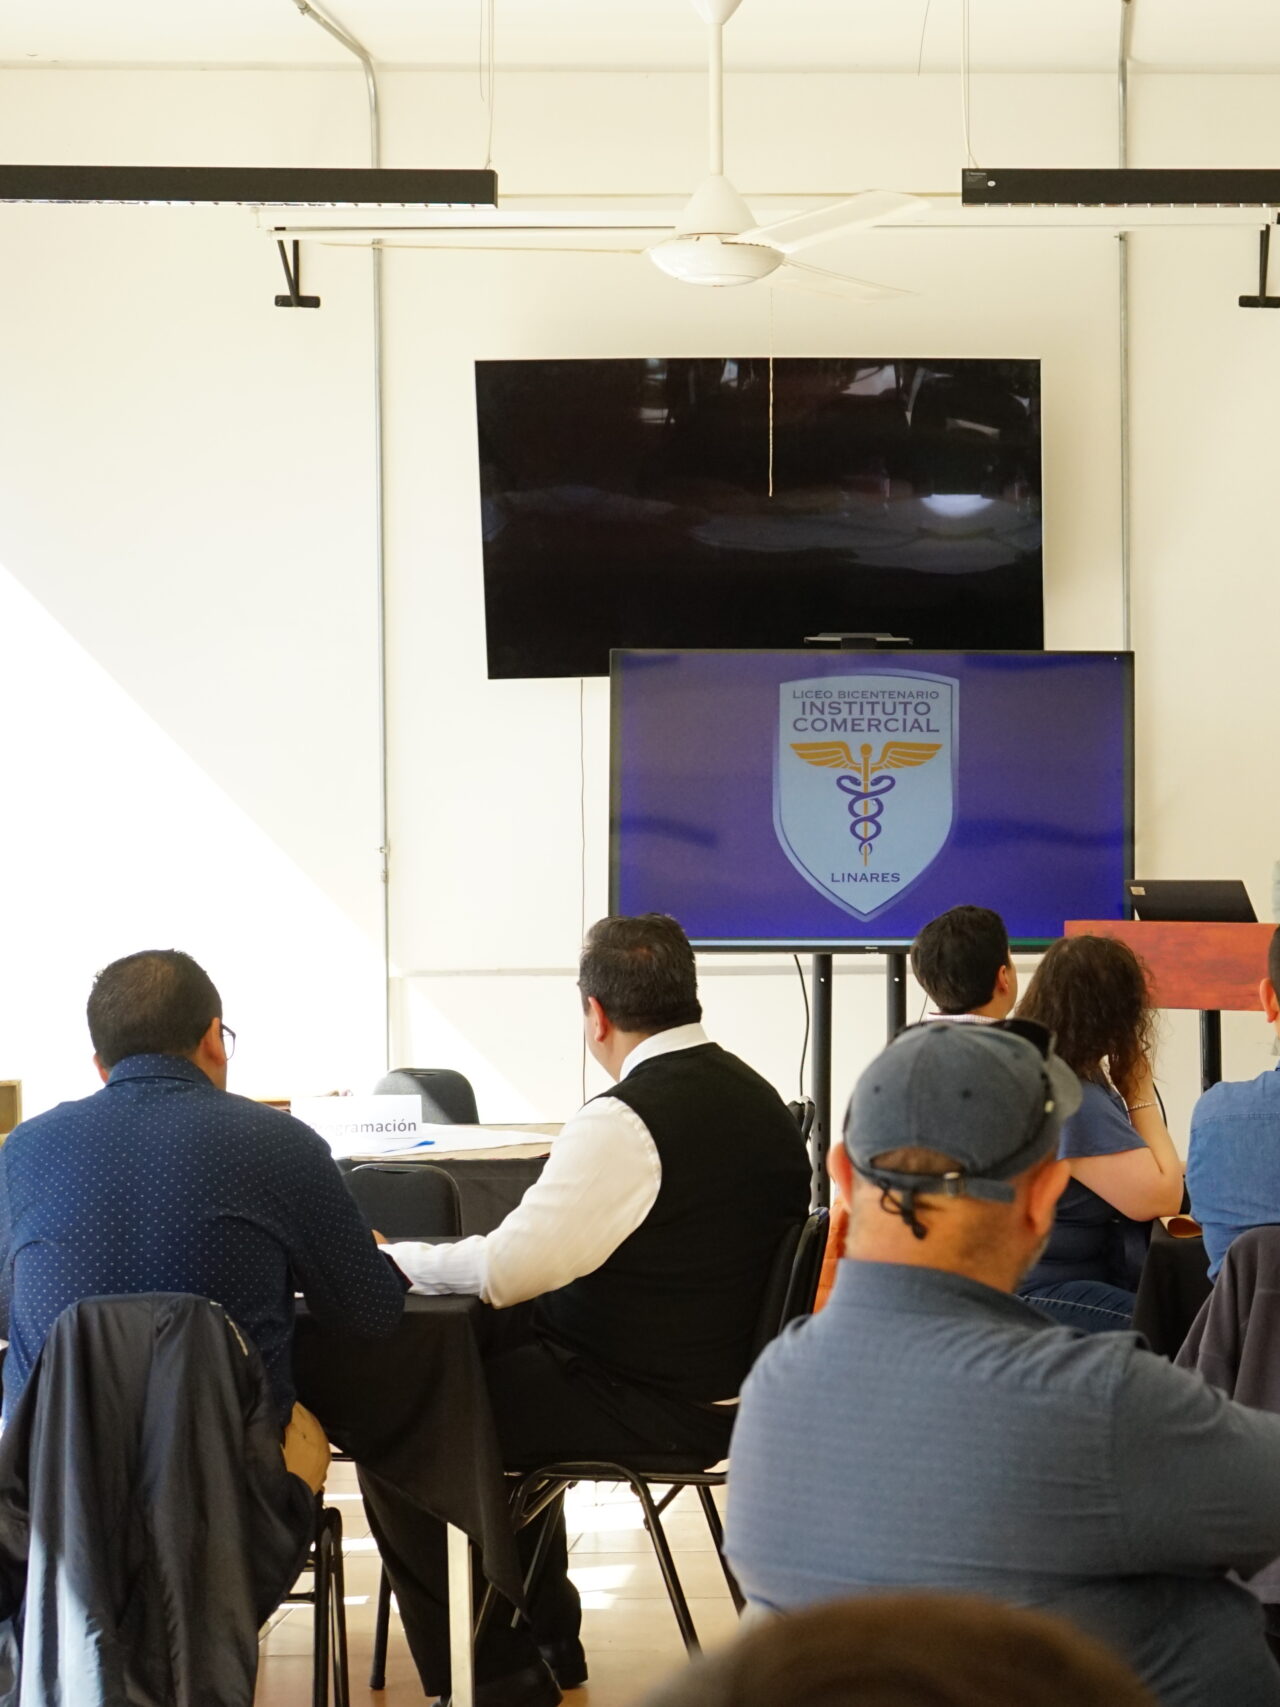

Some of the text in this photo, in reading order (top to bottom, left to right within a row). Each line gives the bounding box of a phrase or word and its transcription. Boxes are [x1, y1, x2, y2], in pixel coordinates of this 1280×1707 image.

[792, 690, 940, 700] LICEO BICENTENARIO
[801, 701, 931, 716] INSTITUTO
[792, 717, 940, 733] COMERCIAL
[831, 872, 901, 883] LINARES
[310, 1118, 417, 1136] ogramación
